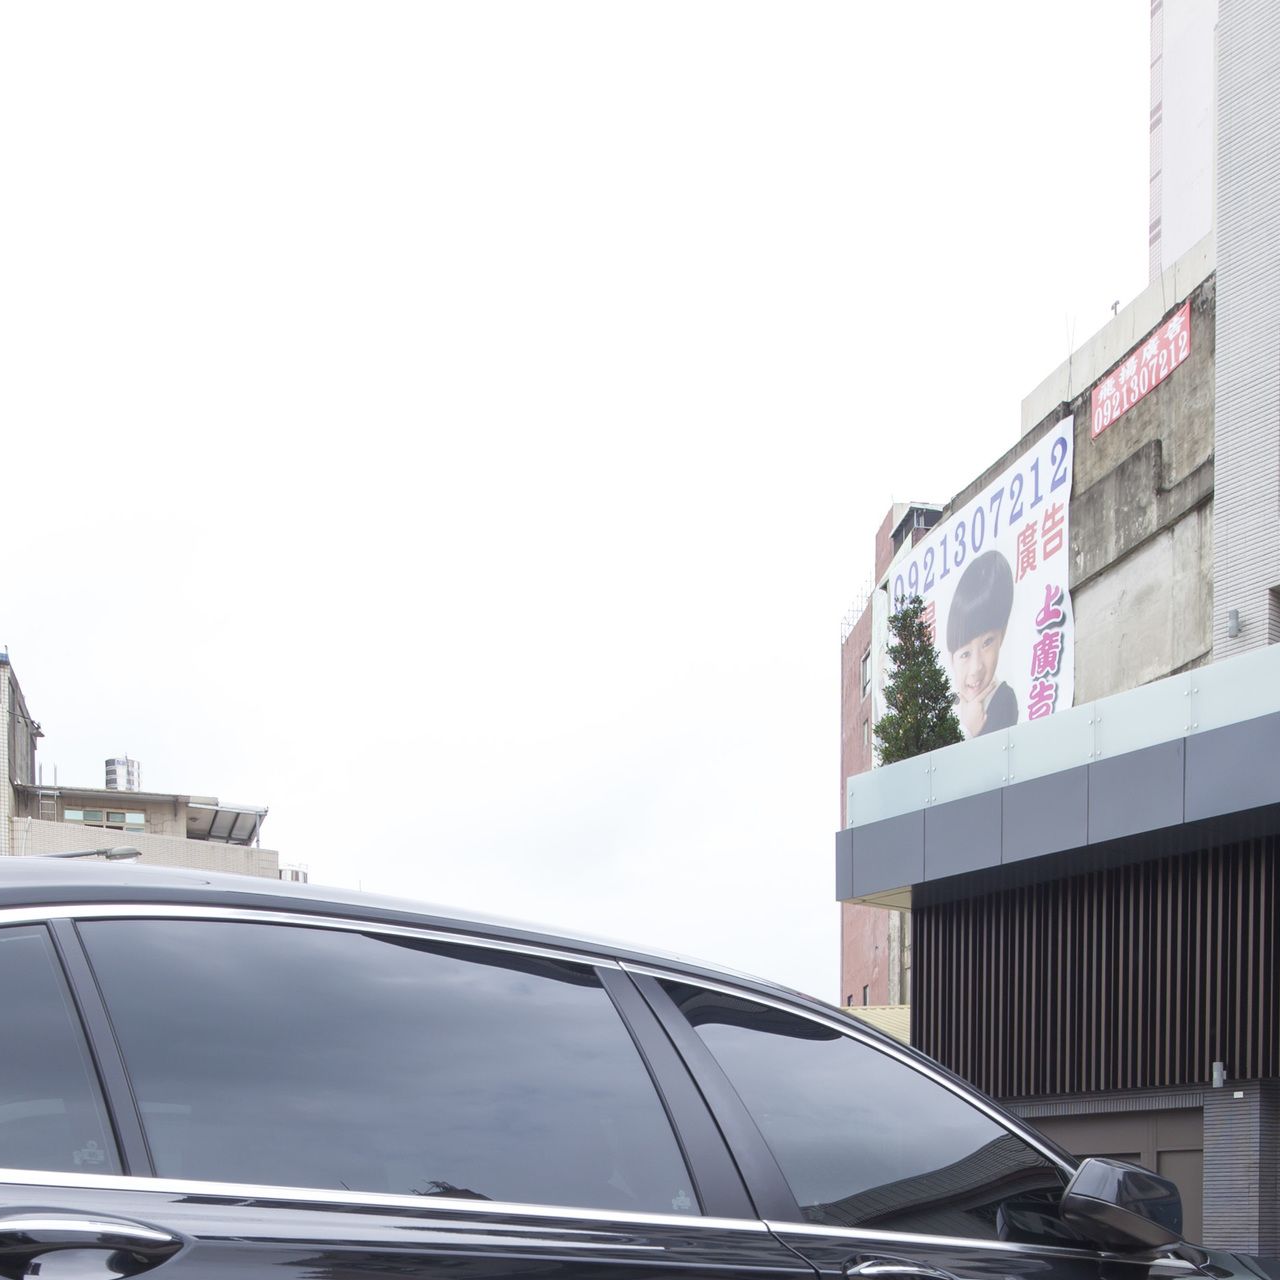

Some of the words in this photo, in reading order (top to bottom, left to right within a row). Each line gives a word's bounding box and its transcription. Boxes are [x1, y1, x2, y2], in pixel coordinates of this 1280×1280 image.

[1094, 330, 1188, 433] 0921307212
[893, 436, 1068, 615] 0921307212
[1027, 583, 1063, 720] 上廣告
